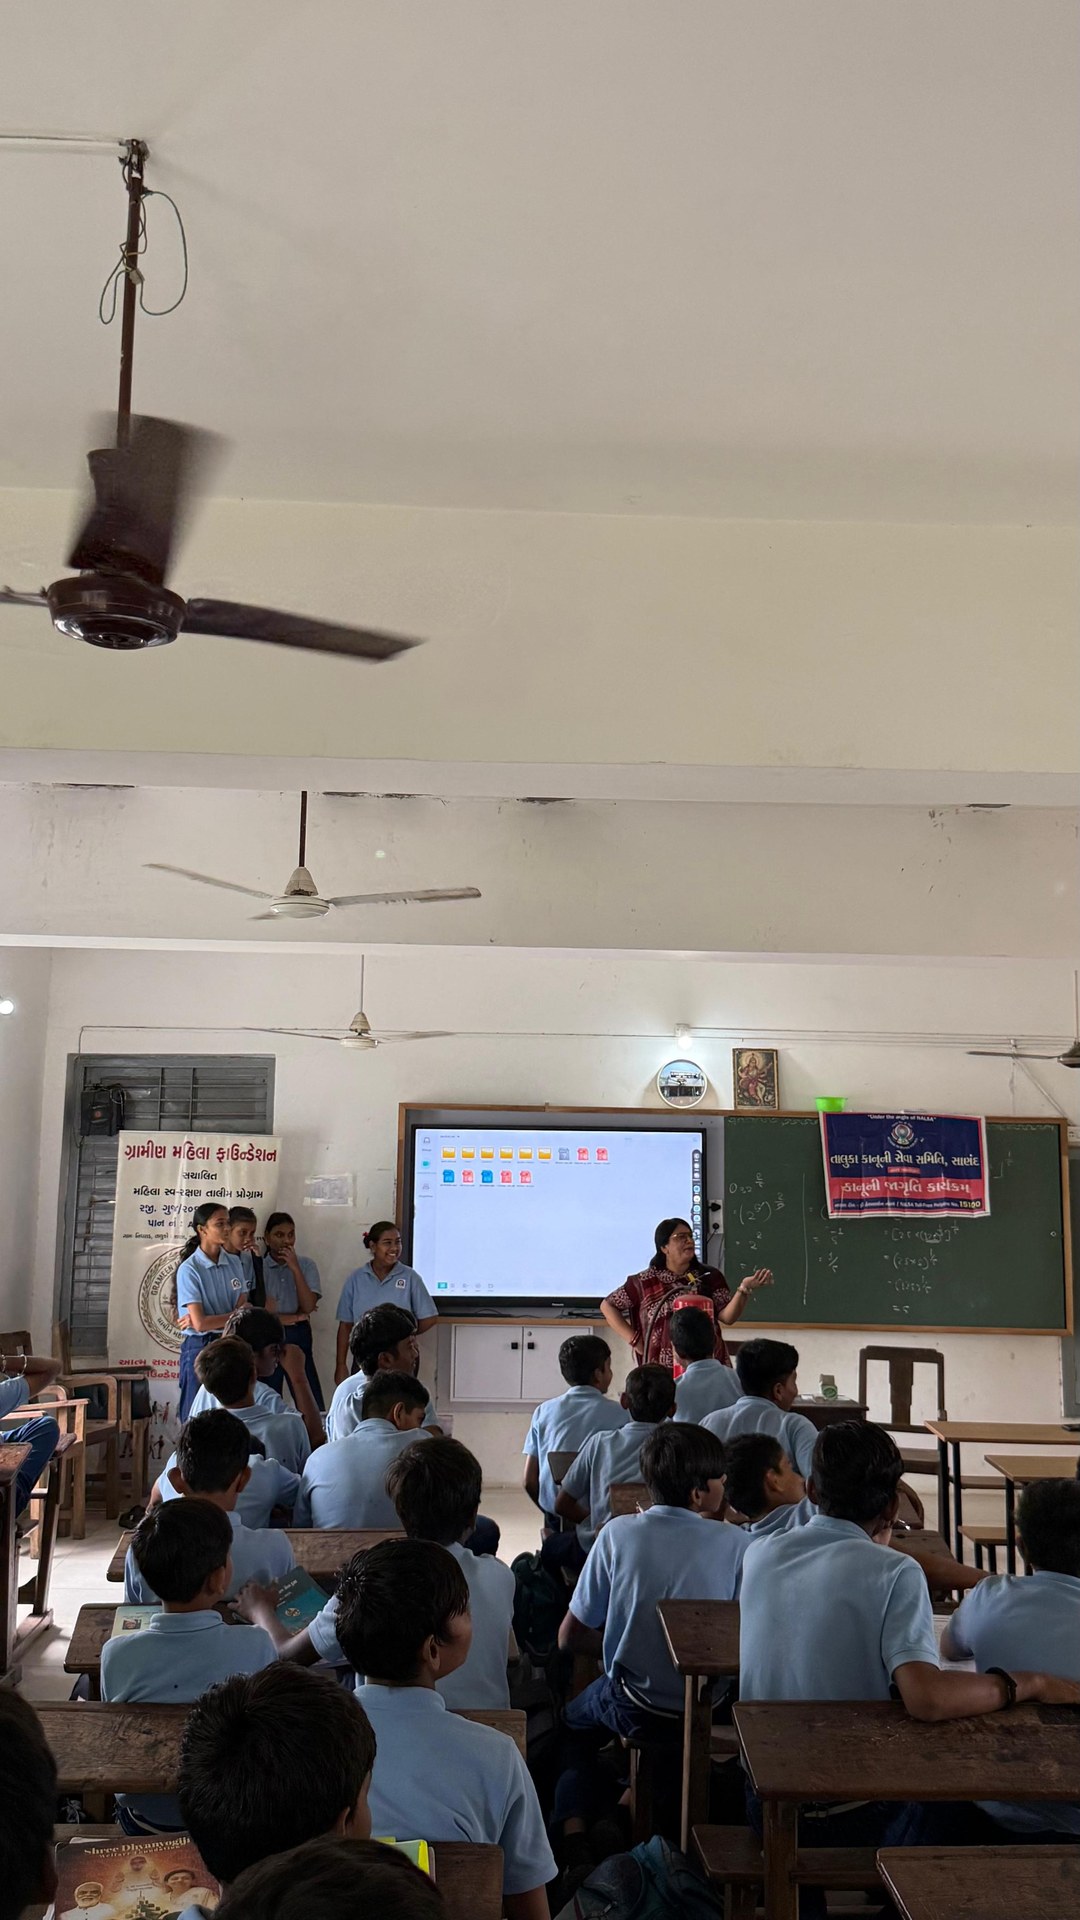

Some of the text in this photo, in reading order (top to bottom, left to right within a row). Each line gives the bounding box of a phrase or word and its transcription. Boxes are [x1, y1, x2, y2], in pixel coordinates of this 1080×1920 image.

[124, 1140, 277, 1163] ગ્રામીણ મહિલા ફાઉન્ડેશન
[830, 1150, 980, 1168] તાલુકા કાનૂની સેવા સમિતિ, સાણંદ
[133, 1185, 161, 1197] મહિલા
[205, 1186, 233, 1199] તાલીમ
[236, 1187, 264, 1200] પ્રોગ્રામ
[841, 1178, 881, 1197] કાનૂની
[884, 1178, 922, 1196] જાગૃતિ
[959, 1200, 981, 1208] 15100
[147, 1218, 165, 1228] પાન
[150, 1265, 174, 1296] GRAMEEN
